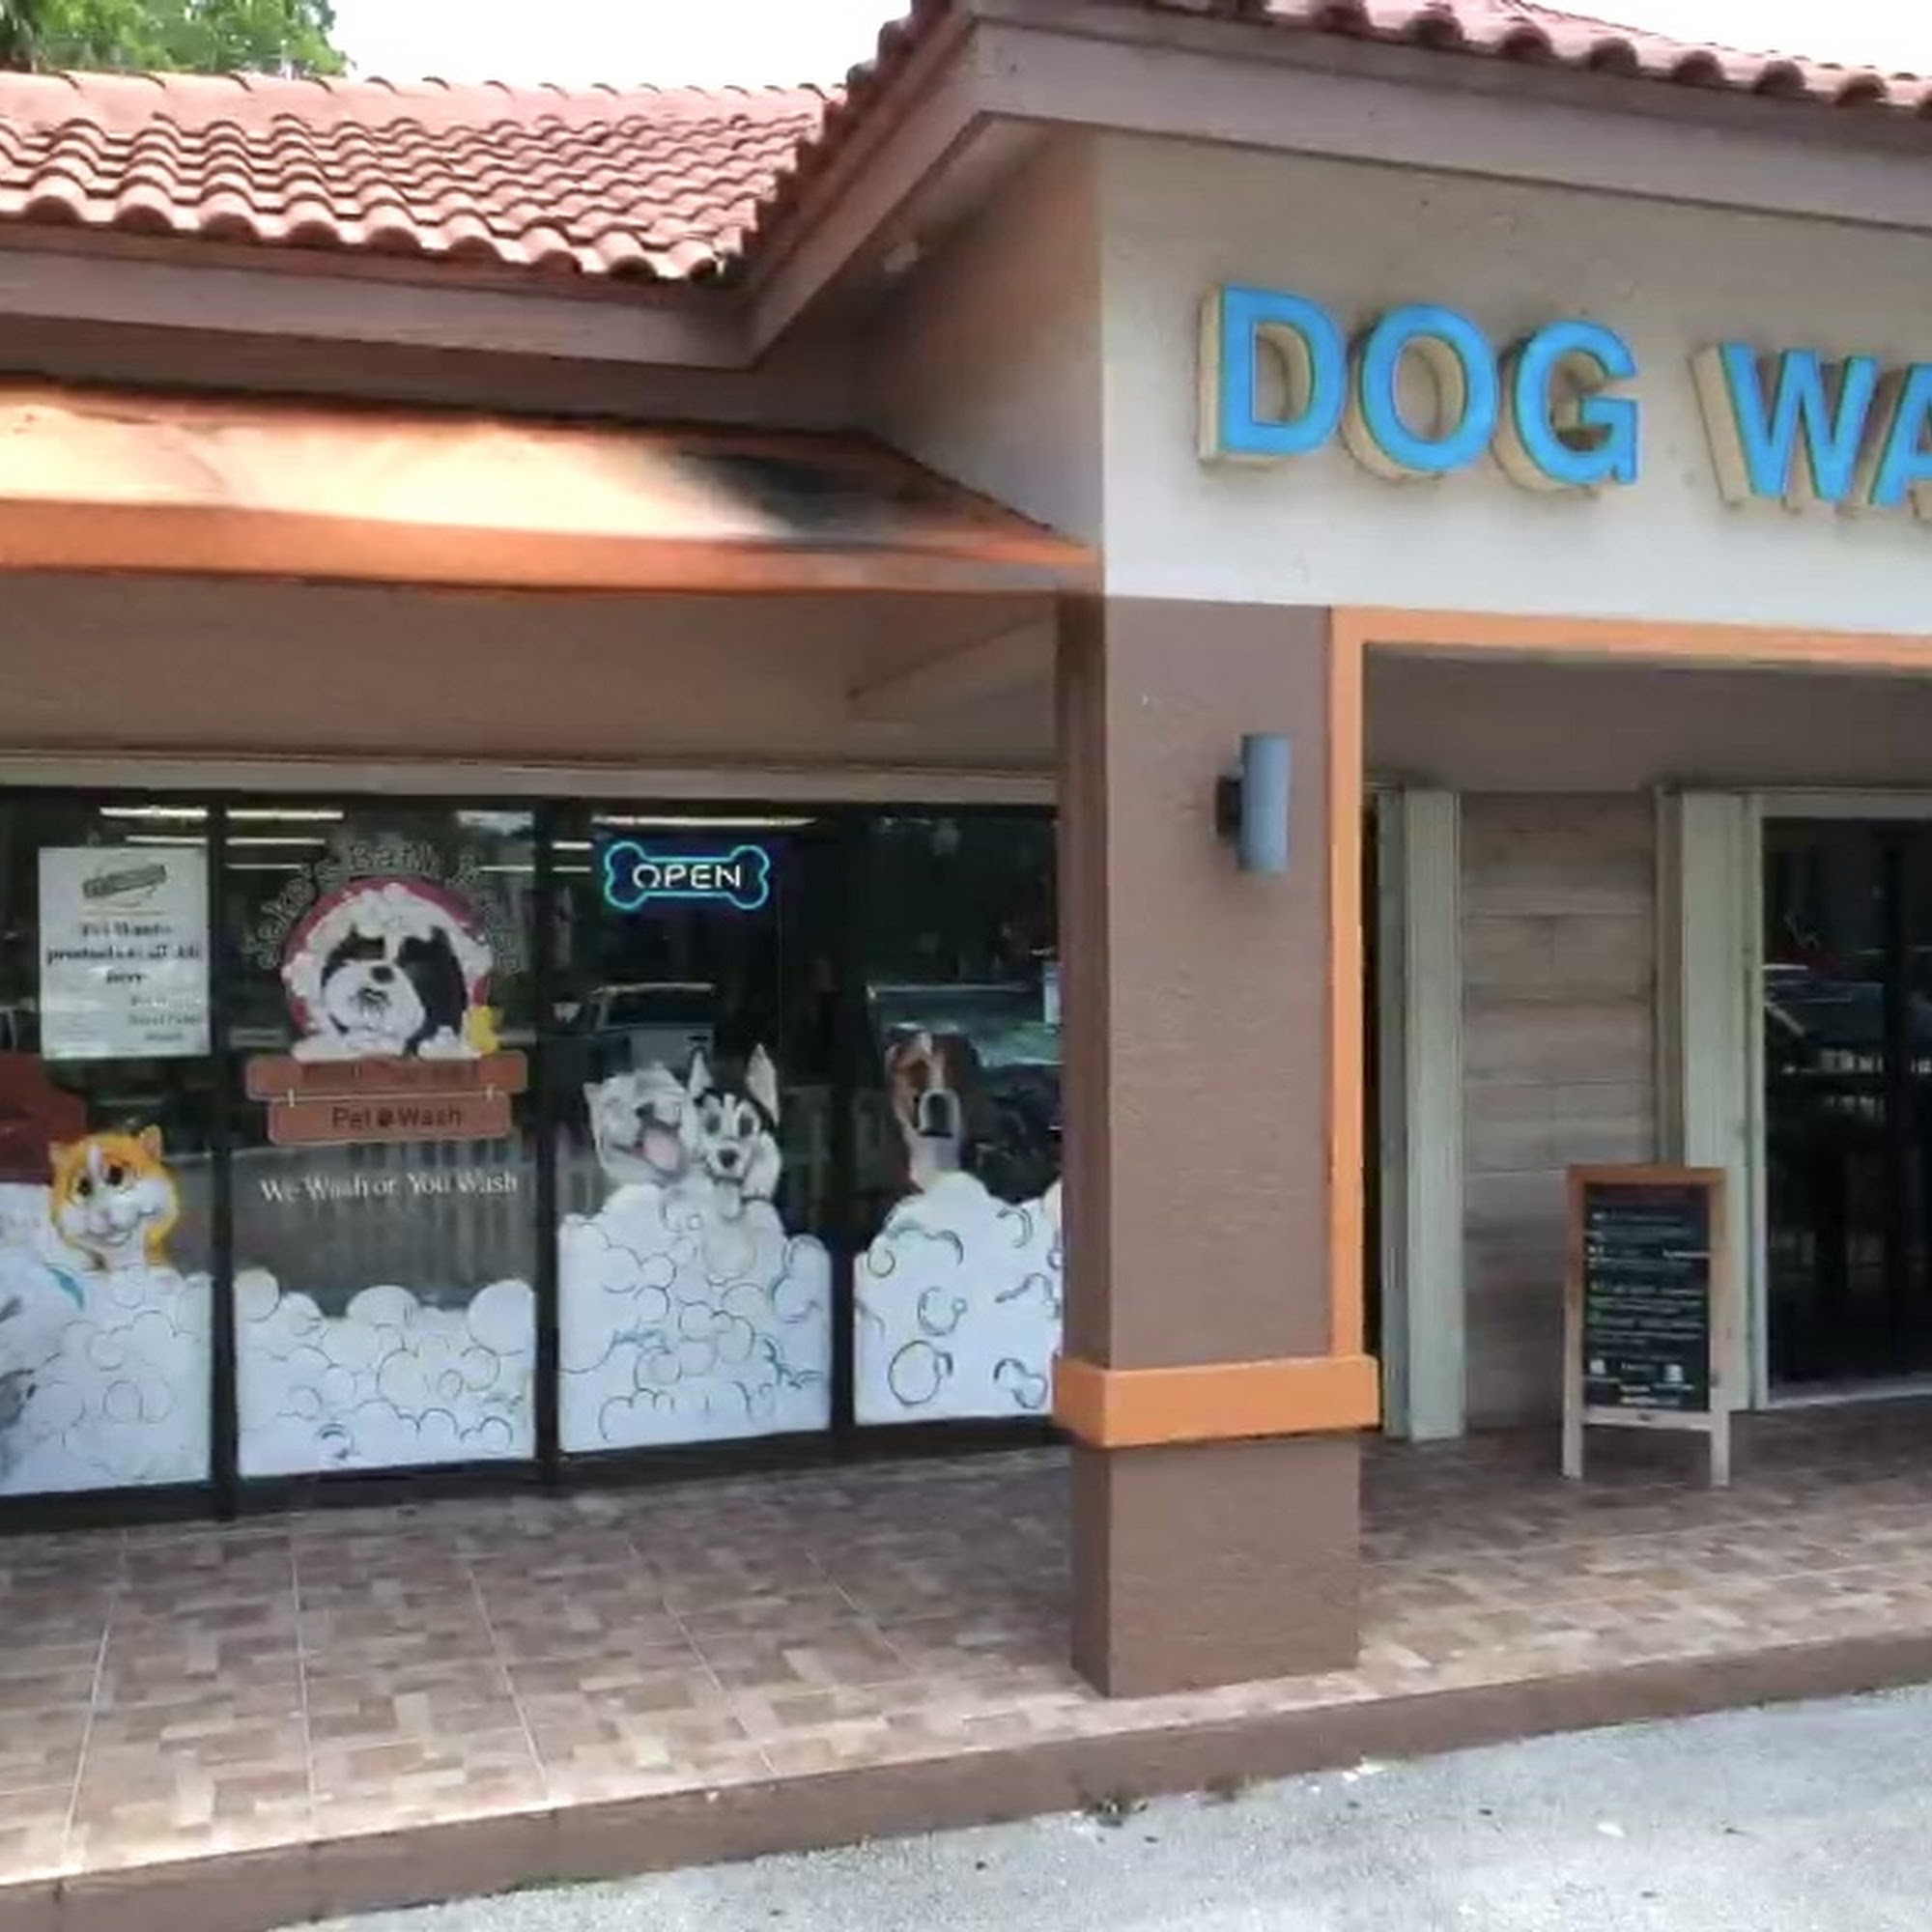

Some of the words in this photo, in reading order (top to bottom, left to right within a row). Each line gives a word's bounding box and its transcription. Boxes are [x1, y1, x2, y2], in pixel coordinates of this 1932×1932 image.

[1202, 284, 1639, 493] DOG
[632, 863, 741, 890] OPEN
[332, 1107, 372, 1128] Pet
[402, 1105, 463, 1127] Wash
[407, 1172, 450, 1194] You
[458, 1168, 518, 1195] Wash
